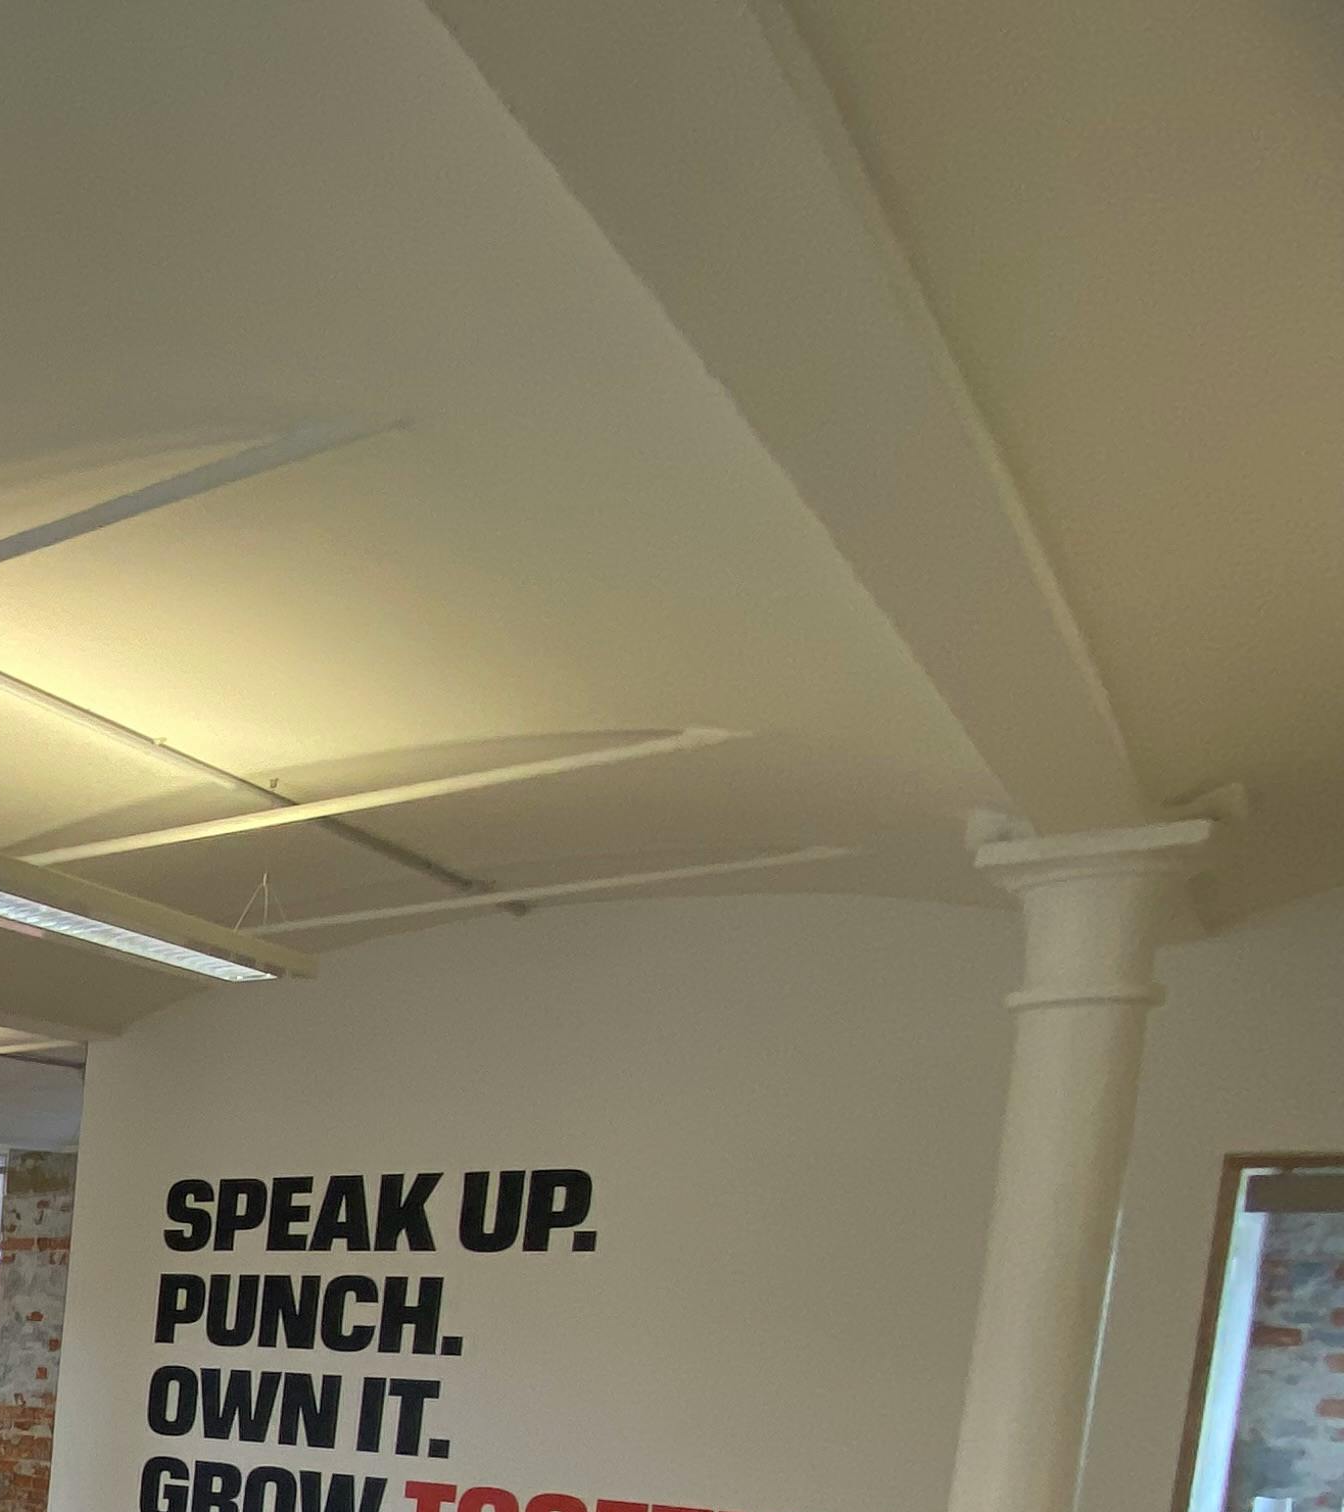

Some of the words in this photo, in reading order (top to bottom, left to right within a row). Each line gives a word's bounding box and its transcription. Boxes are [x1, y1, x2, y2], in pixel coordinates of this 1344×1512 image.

[163, 1171, 445, 1253] SPEAK
[458, 1168, 598, 1253] UP.
[154, 1273, 464, 1357] PUNCH.
[147, 1365, 343, 1449] OWN
[356, 1376, 451, 1459] IT.
